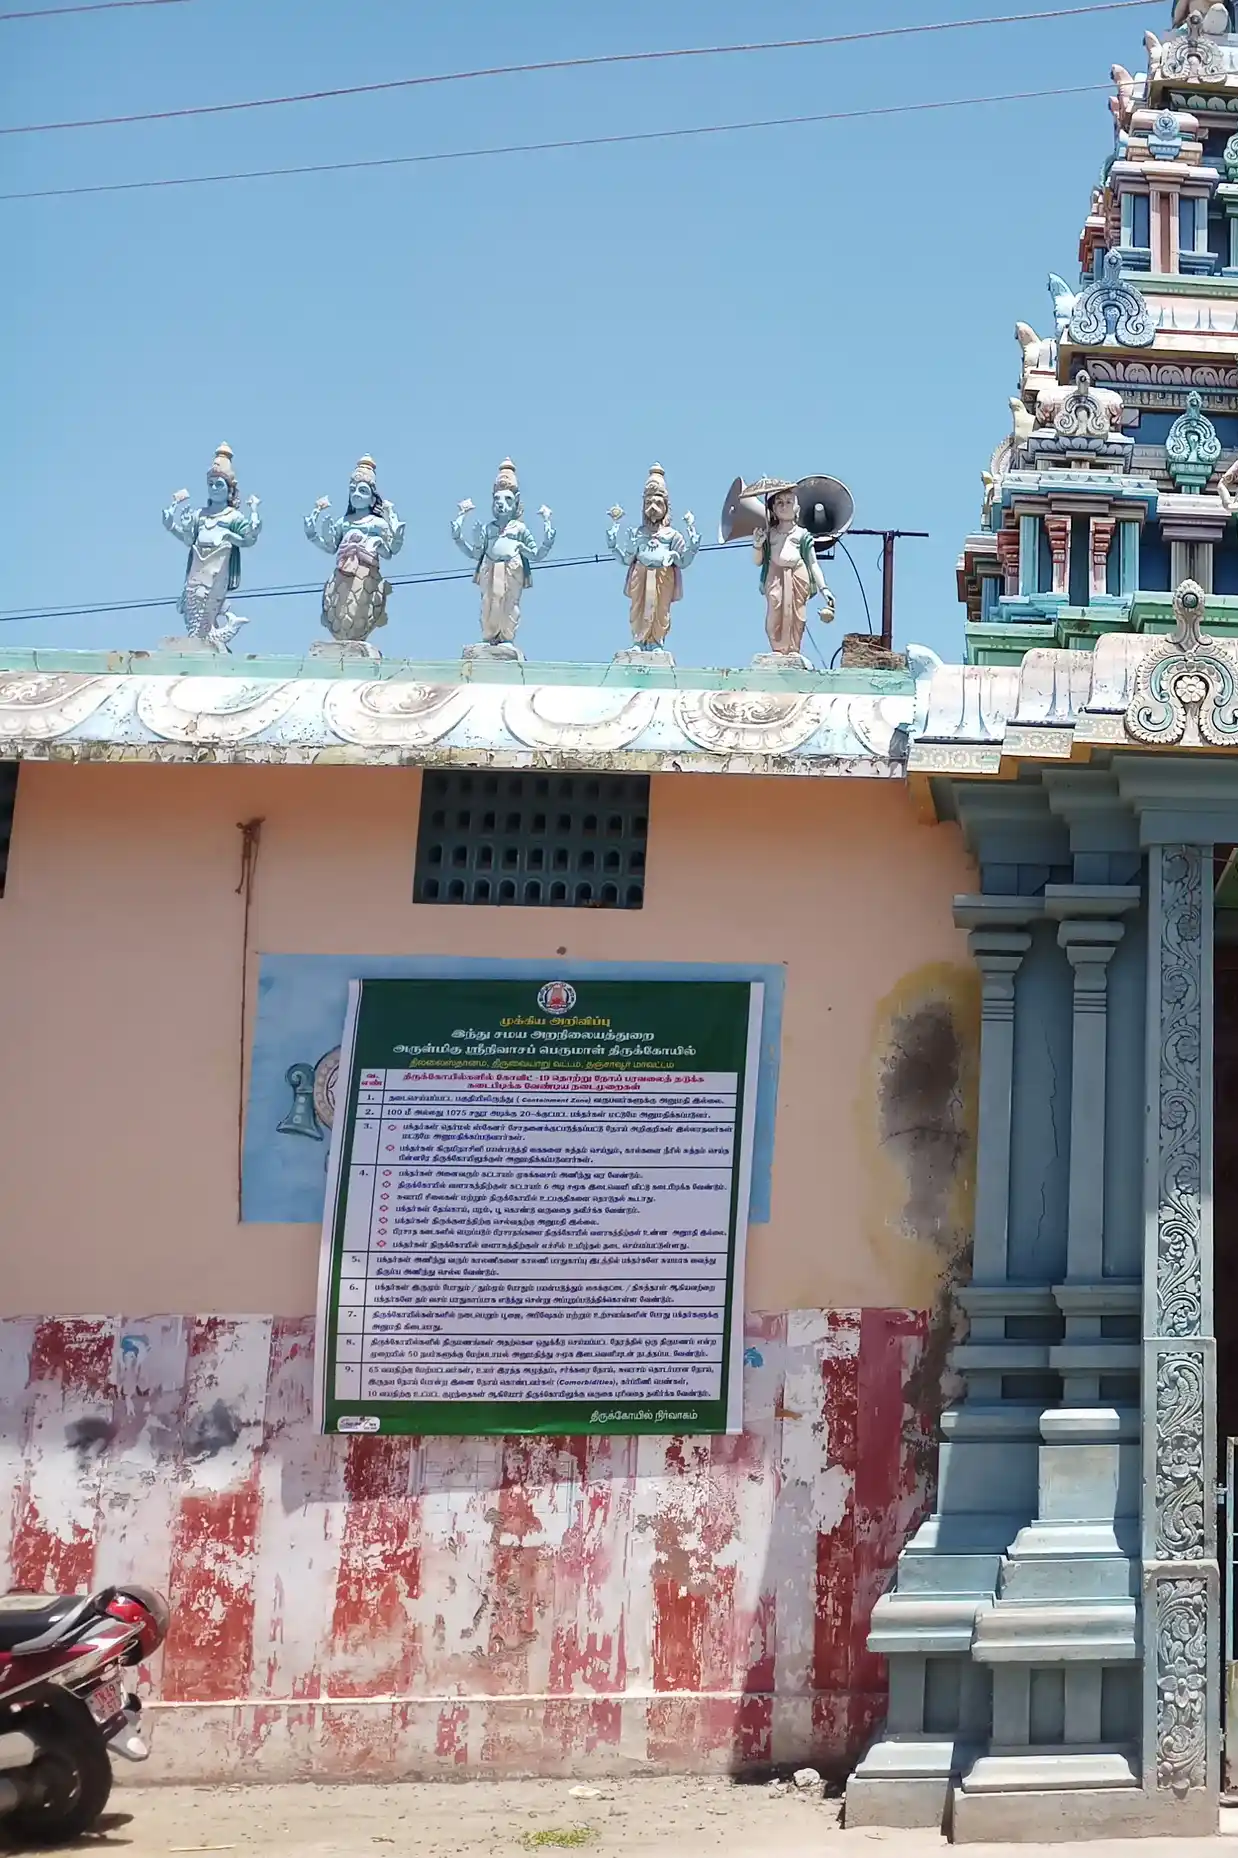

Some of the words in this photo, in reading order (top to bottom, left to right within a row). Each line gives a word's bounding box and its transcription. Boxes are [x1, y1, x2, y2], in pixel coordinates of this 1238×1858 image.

[450, 1028, 491, 1040] இந்து
[493, 1031, 527, 1039] சமய
[529, 1030, 655, 1042] அறநிலையத்துறை
[445, 1109, 467, 1117] 1075
[588, 1410, 653, 1422] திருக்கோயில்
[654, 1410, 698, 1422] நிர்வாகம்
